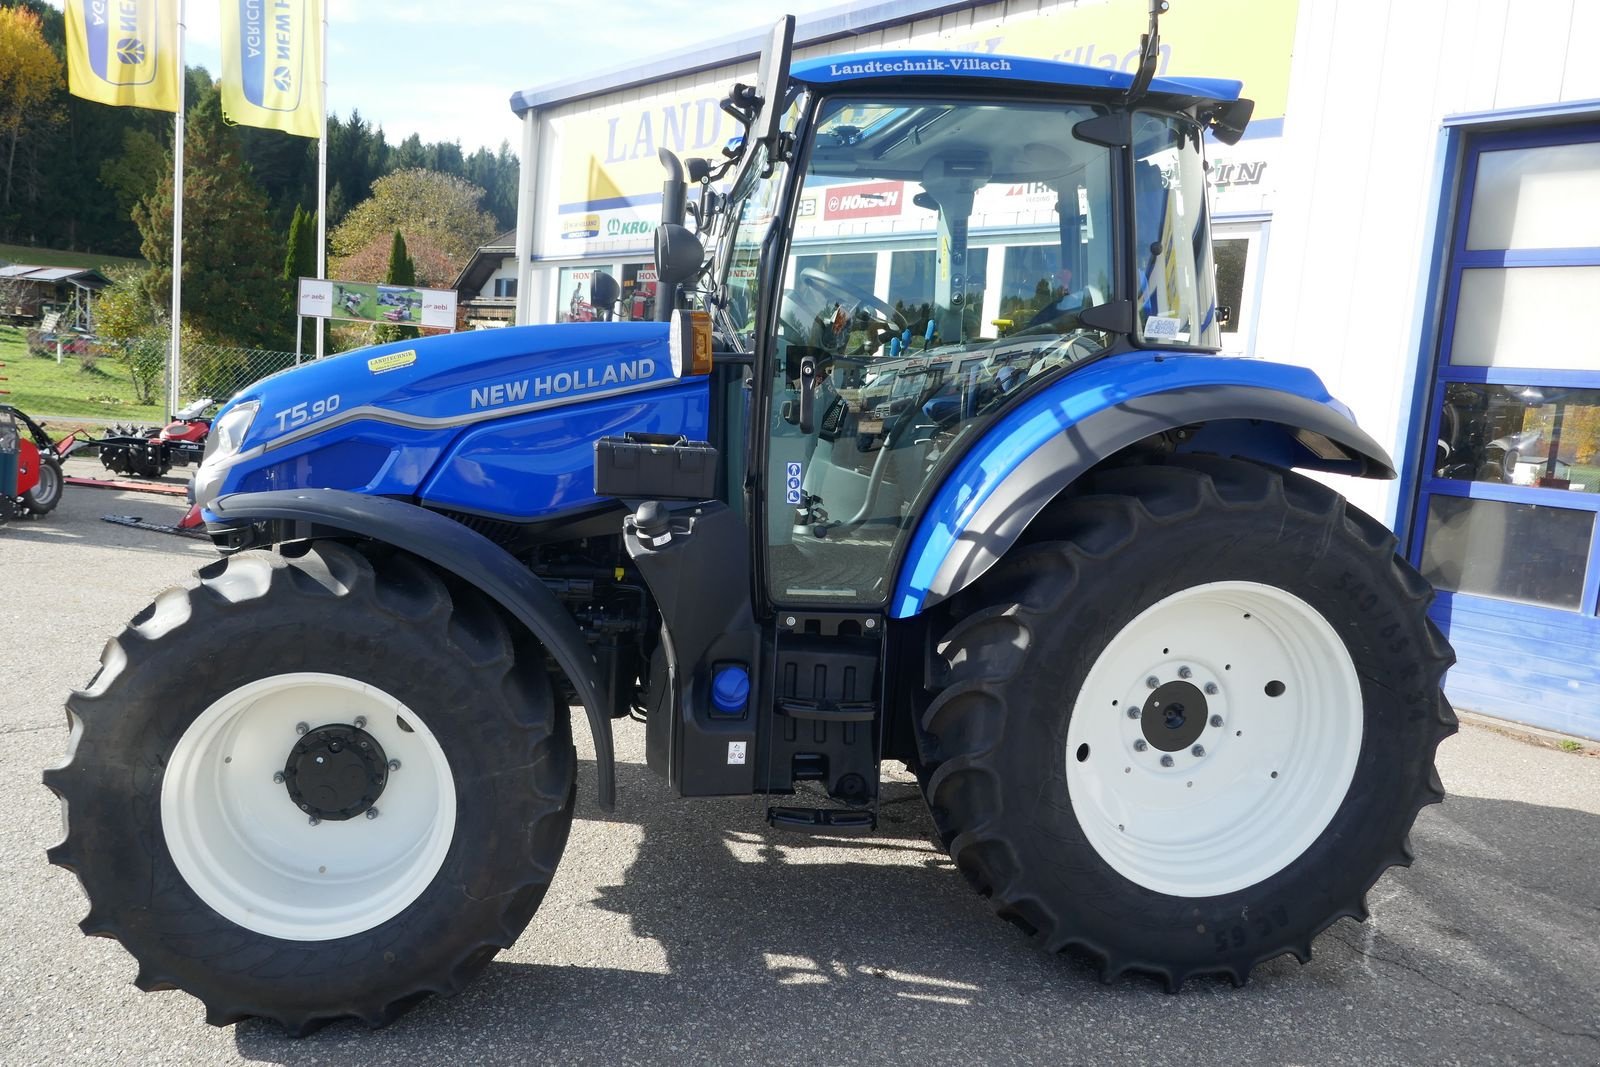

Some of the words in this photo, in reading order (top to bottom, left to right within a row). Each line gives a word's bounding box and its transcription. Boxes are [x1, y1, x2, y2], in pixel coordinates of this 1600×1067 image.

[829, 58, 1012, 76] Landtechnik-Villach
[604, 97, 744, 164] LAND
[841, 191, 899, 211] HORSCH
[572, 272, 590, 280] HON
[639, 272, 657, 280] HON
[470, 379, 529, 409] NEW
[534, 358, 656, 397] HOLLAND
[275, 394, 340, 432] T5.90
